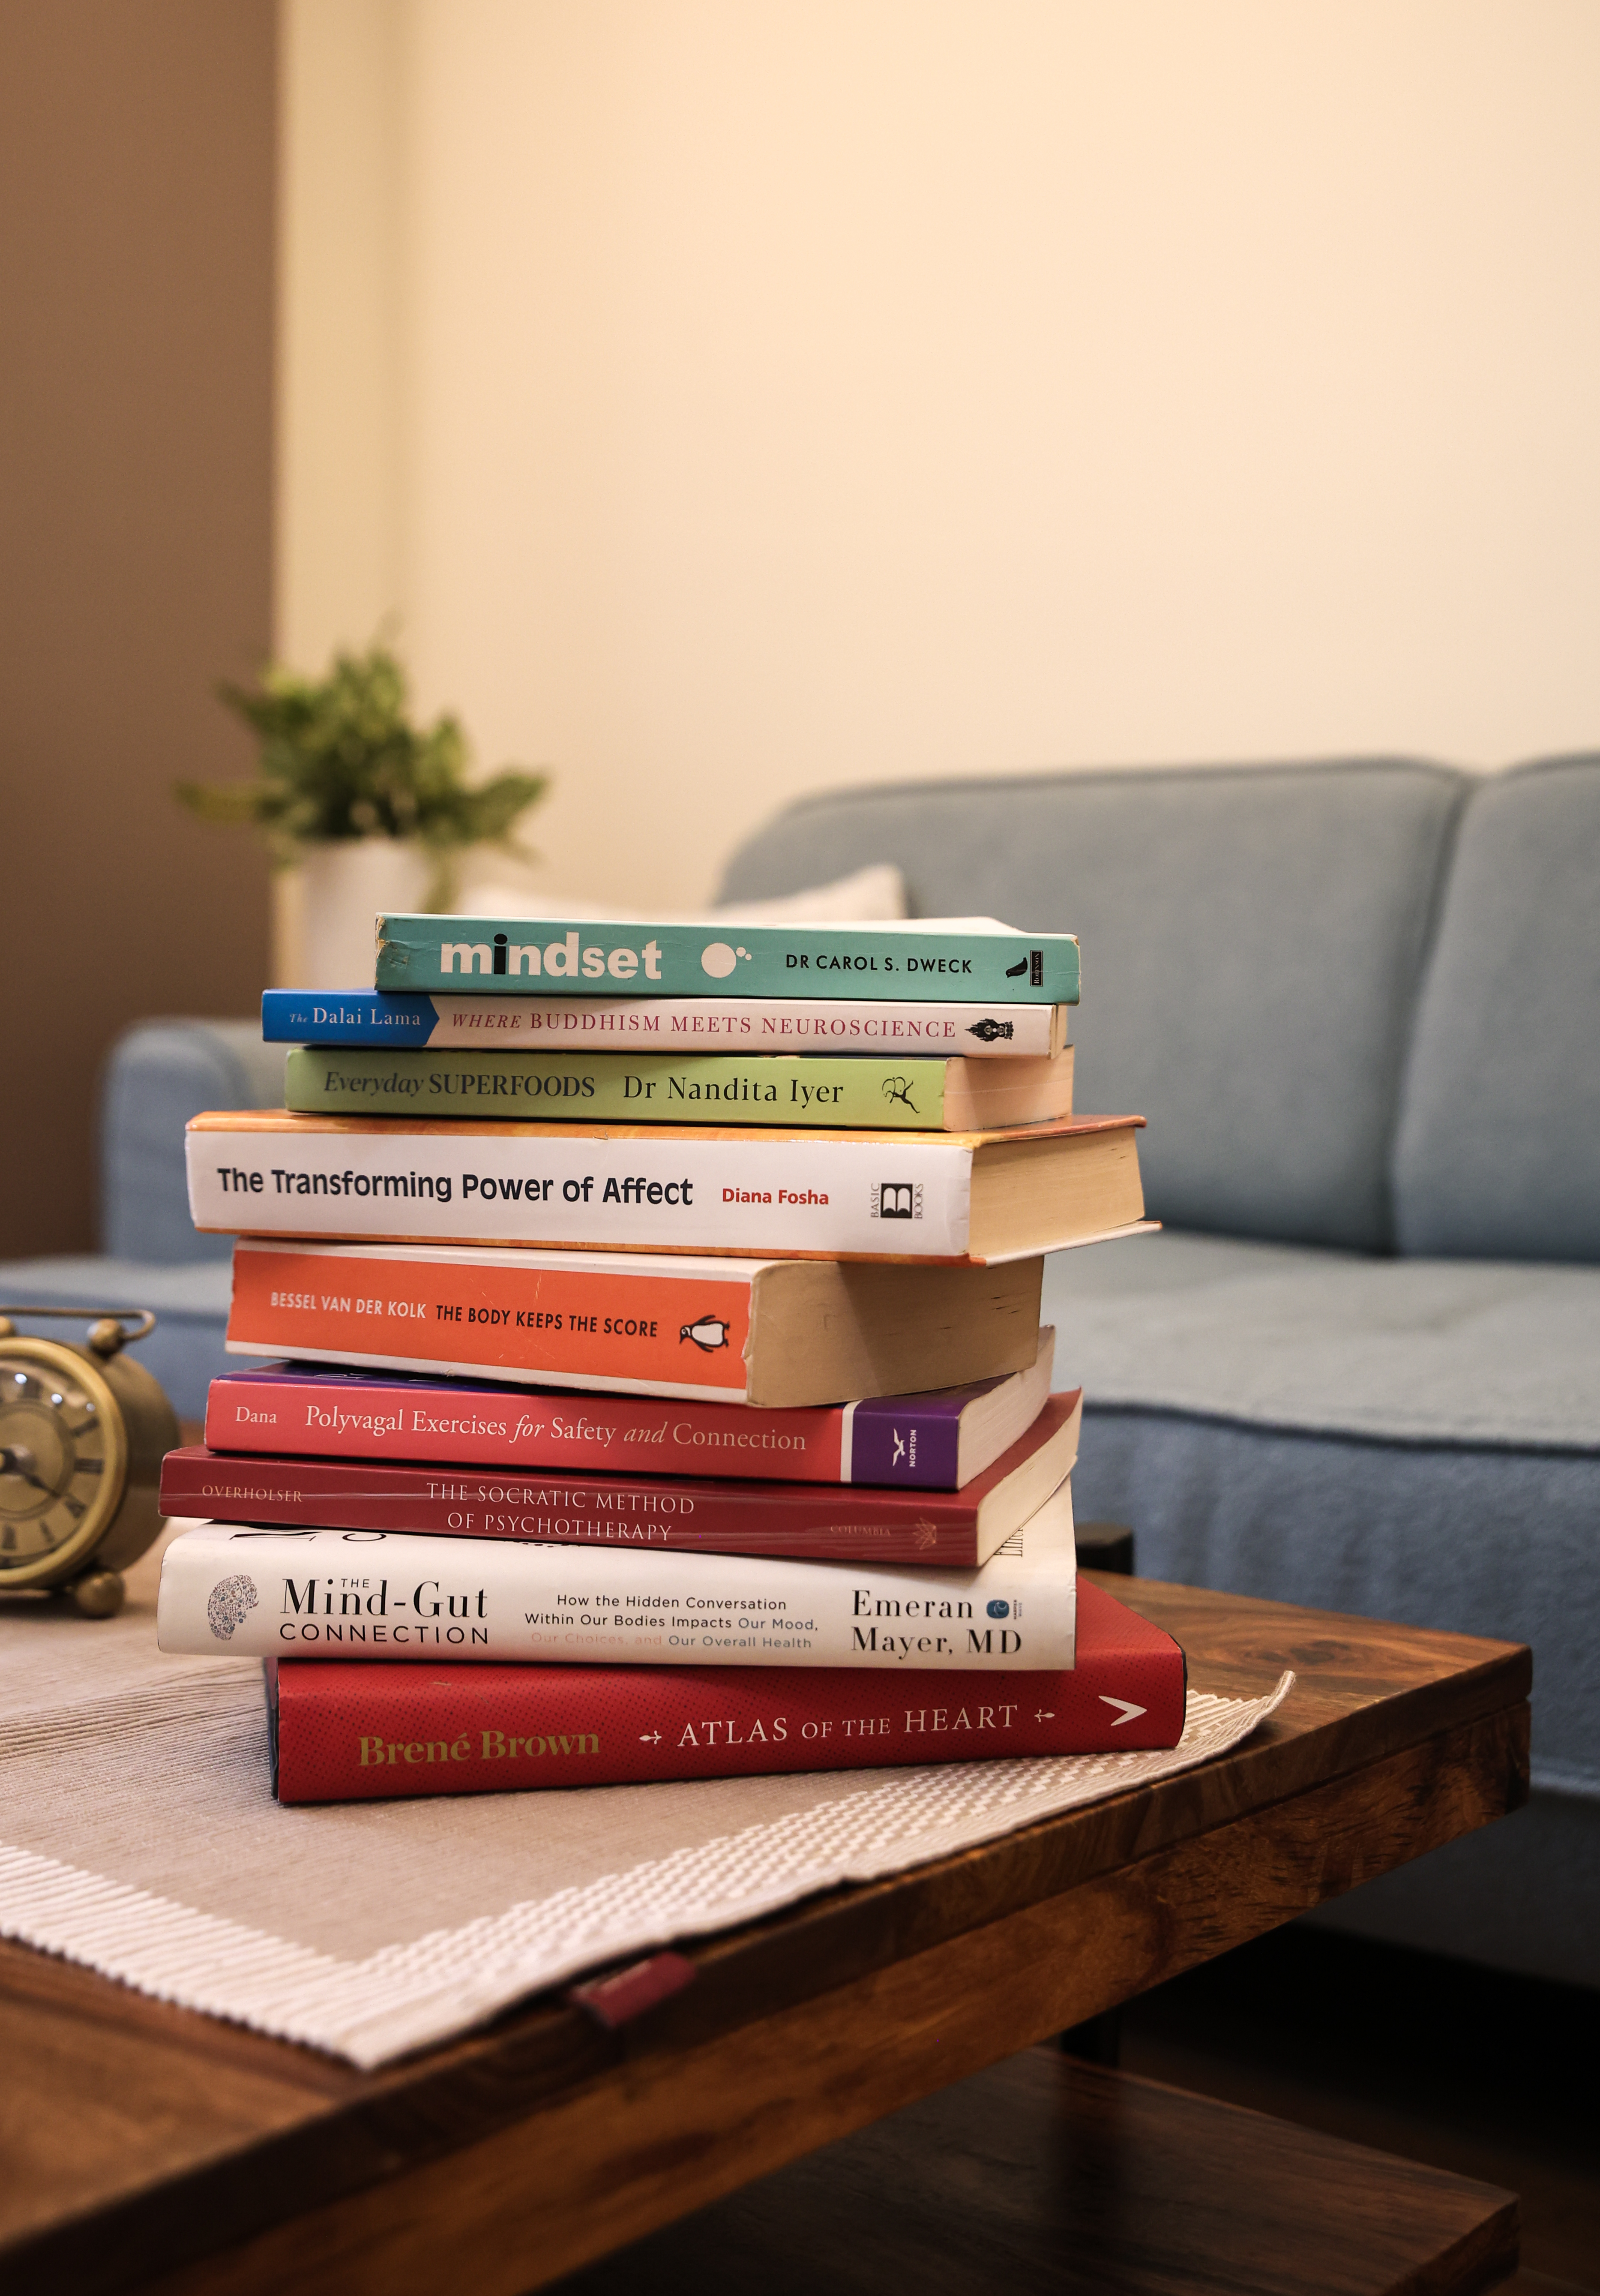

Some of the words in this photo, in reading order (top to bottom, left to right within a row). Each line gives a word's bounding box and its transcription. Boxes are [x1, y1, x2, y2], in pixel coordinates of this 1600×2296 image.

[441, 932, 662, 979] mindset
[786, 954, 809, 968] DR
[816, 955, 877, 970] CAROL
[884, 957, 900, 971] S.
[908, 958, 971, 973] DWECK
[290, 1014, 307, 1023] The
[314, 1008, 361, 1023] Dalai
[371, 1009, 419, 1024] Lama
[452, 1013, 522, 1029] WHERE
[530, 1013, 660, 1031] BUDDHISM
[671, 1016, 750, 1033] MEETS
[762, 1018, 955, 1037] NEUROSCIENCE
[324, 1071, 424, 1098] Everyday
[429, 1074, 596, 1098] SUPERFOODS
[624, 1076, 656, 1098] Dr
[668, 1077, 777, 1101] Nandita
[791, 1080, 843, 1108] Iyer
[217, 1168, 263, 1193] The
[271, 1170, 451, 1202] Transforming
[463, 1174, 553, 1201] Power
[563, 1177, 593, 1202] of
[602, 1177, 693, 1205] Affect
[723, 1188, 771, 1203] Diana
[779, 1189, 828, 1204] Fosha
[869, 1182, 880, 1218] BASIC
[914, 1182, 924, 1219] BOOKS
[271, 1292, 316, 1309] BESSEL
[321, 1296, 351, 1312] VAN
[356, 1299, 382, 1315] DER
[388, 1301, 426, 1318] KOLK
[437, 1305, 462, 1321] THE
[469, 1308, 510, 1324] BODY
[517, 1311, 562, 1329] KEEPS
[569, 1315, 597, 1332] THE
[604, 1318, 657, 1337] SCORE
[236, 1407, 276, 1423] Dana
[306, 1405, 403, 1436] Polyvagal
[411, 1411, 506, 1435] Exercises
[509, 1414, 545, 1443] for
[551, 1417, 616, 1447] Safety
[624, 1421, 668, 1443] and
[673, 1423, 806, 1450] Connection
[908, 1428, 917, 1468] NORTON
[202, 1485, 303, 1502] OVERHOLSER
[426, 1483, 468, 1501] THE
[479, 1486, 585, 1507] SOCRATIC
[596, 1493, 694, 1513] METHOD
[448, 1513, 474, 1528] OF
[485, 1515, 671, 1541] PSYCHOTHERAPY
[341, 1579, 369, 1588] THE
[280, 1578, 488, 1618] Mind-Gut
[557, 1594, 589, 1606] How
[596, 1595, 619, 1606] the
[626, 1596, 679, 1607] Hidden
[686, 1597, 786, 1610] Conversation
[852, 1589, 973, 1618] Emeran
[280, 1624, 487, 1644] CONNECTION
[525, 1613, 573, 1624] Within
[581, 1615, 607, 1625] Our
[615, 1615, 665, 1627] Bodies
[672, 1617, 731, 1629] Impacts
[738, 1618, 765, 1629] Our
[773, 1619, 818, 1631] Mood,
[531, 1632, 558, 1643] Our
[635, 1635, 662, 1645] and
[669, 1636, 695, 1645] Our
[703, 1636, 755, 1647] Overall
[763, 1638, 811, 1648] Health
[851, 1626, 953, 1660] Mayer,
[966, 1629, 1022, 1654] MD
[677, 1718, 787, 1746] ATLAS
[802, 1722, 832, 1738] OF
[842, 1719, 890, 1736] THE
[904, 1705, 1017, 1732] HEART
[358, 1732, 470, 1766] Brené
[479, 1730, 600, 1760] Brown
